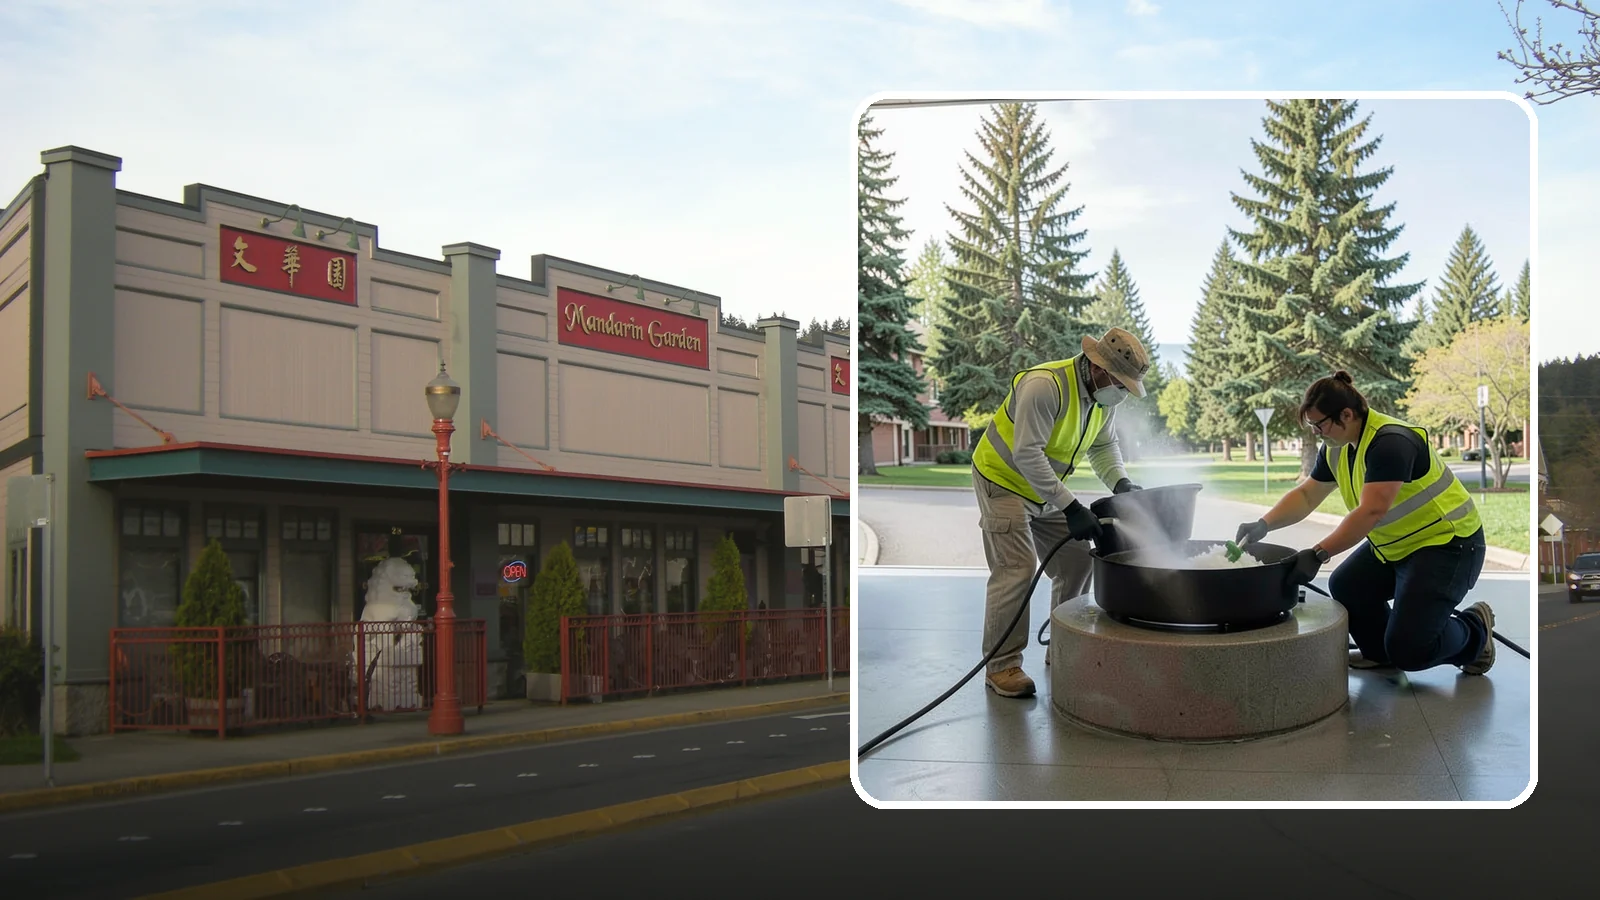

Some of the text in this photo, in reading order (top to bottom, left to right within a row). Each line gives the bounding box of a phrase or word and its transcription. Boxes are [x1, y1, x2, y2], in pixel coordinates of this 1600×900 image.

[231, 236, 346, 290] 文華園
[564, 302, 702, 352] Mandarin Garden
[503, 565, 527, 578] OPEN
